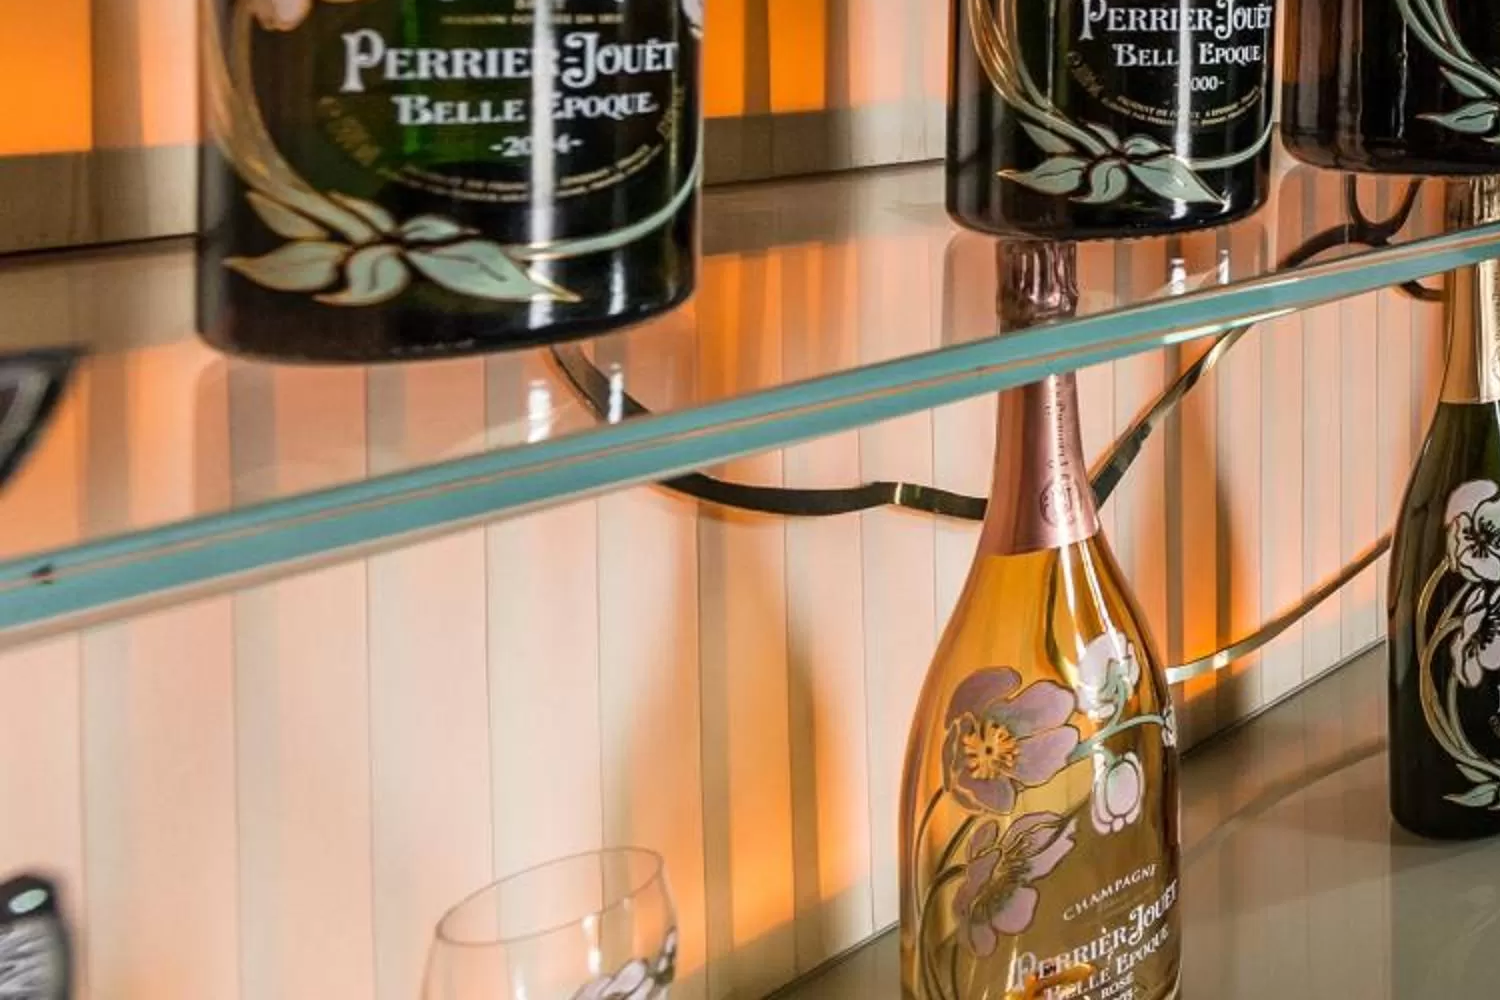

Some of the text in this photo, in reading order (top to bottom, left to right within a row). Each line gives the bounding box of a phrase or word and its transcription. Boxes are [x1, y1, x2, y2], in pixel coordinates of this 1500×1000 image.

[1173, 75, 1225, 92] -000-
[390, 93, 526, 126] BELLE
[489, 134, 584, 158] -204-
